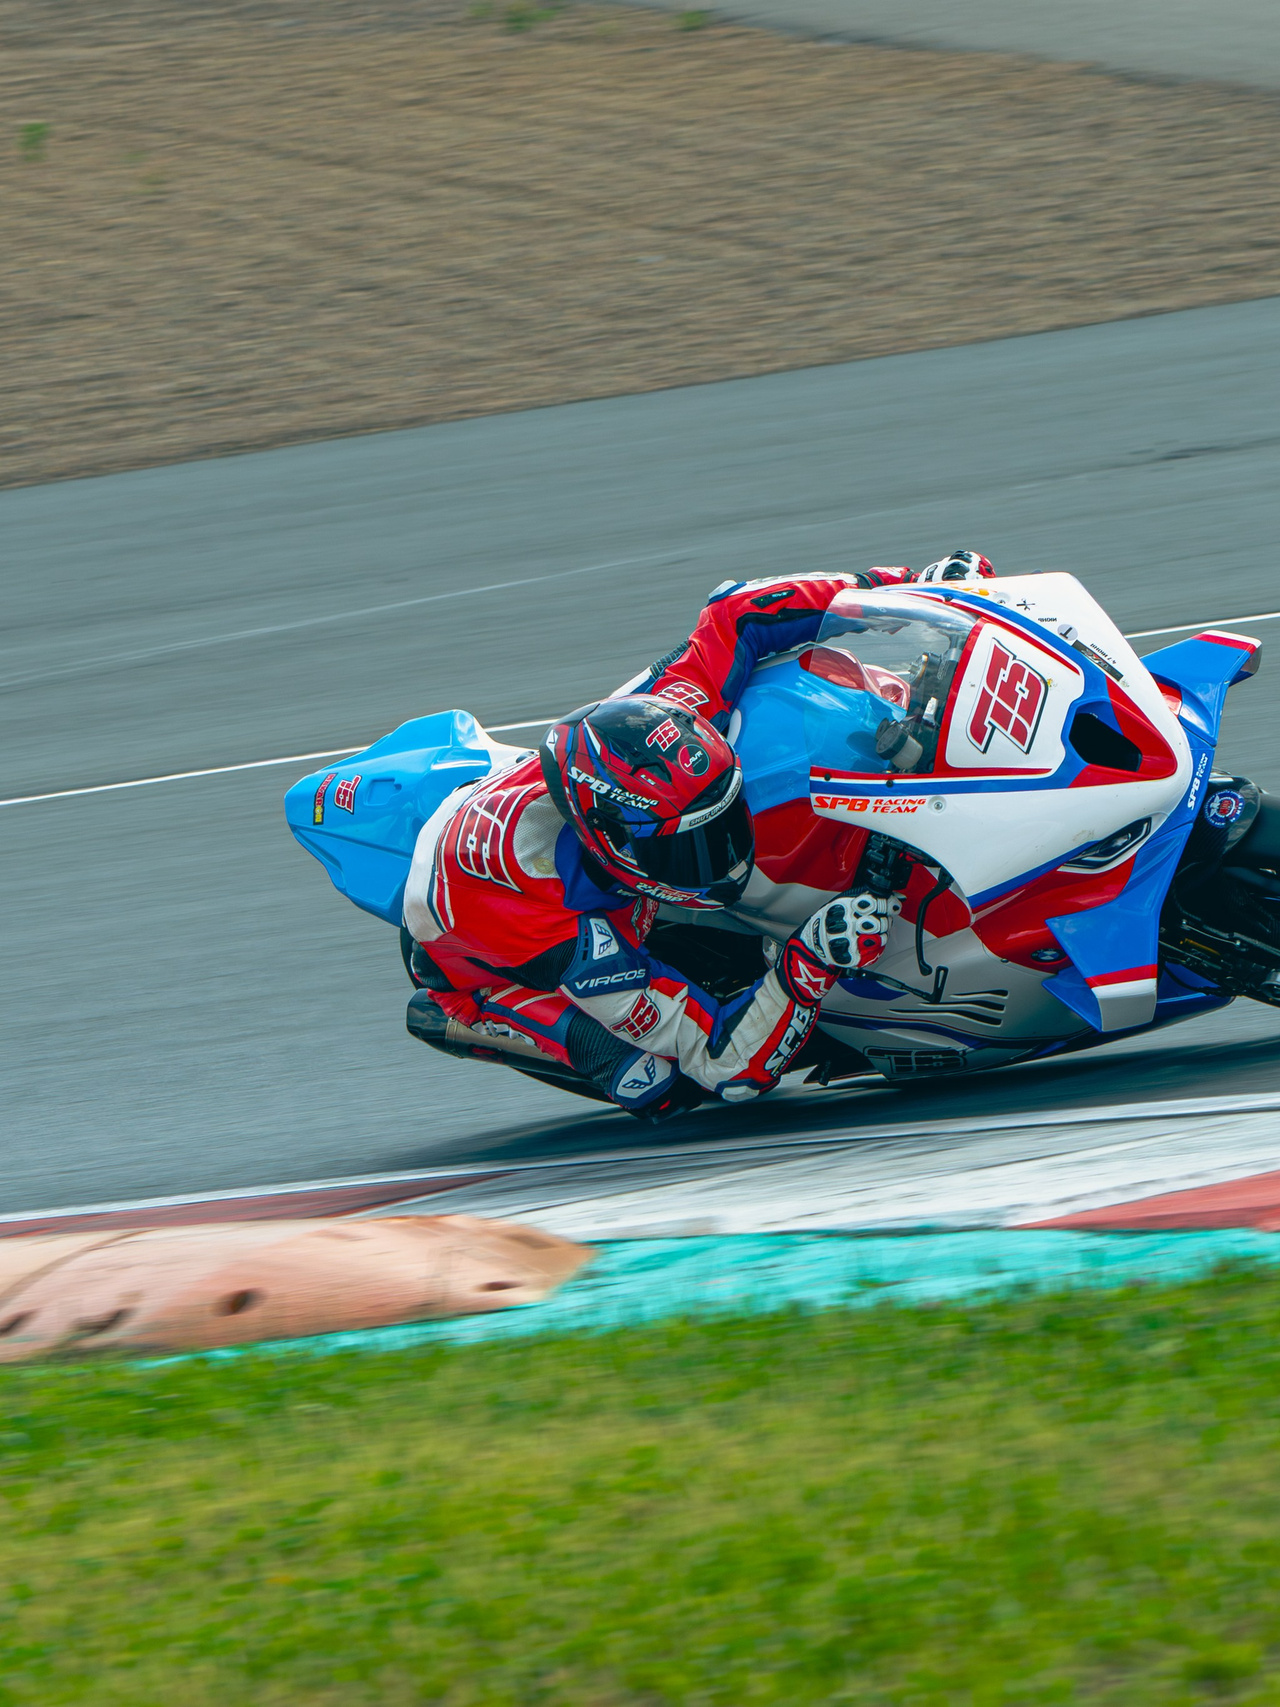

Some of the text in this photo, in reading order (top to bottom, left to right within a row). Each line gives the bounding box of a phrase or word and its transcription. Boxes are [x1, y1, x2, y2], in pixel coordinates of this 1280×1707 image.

[567, 766, 612, 794] SPB
[610, 793, 651, 810] TEAM
[613, 788, 659, 806] RACING
[873, 798, 926, 806] RACING
[1187, 777, 1200, 811] SPB
[814, 796, 870, 812] SPB
[872, 806, 918, 814] TEAM
[575, 969, 646, 990] VIRCOS
[765, 1003, 811, 1075] SPB
[773, 1041, 801, 1078] RACING
